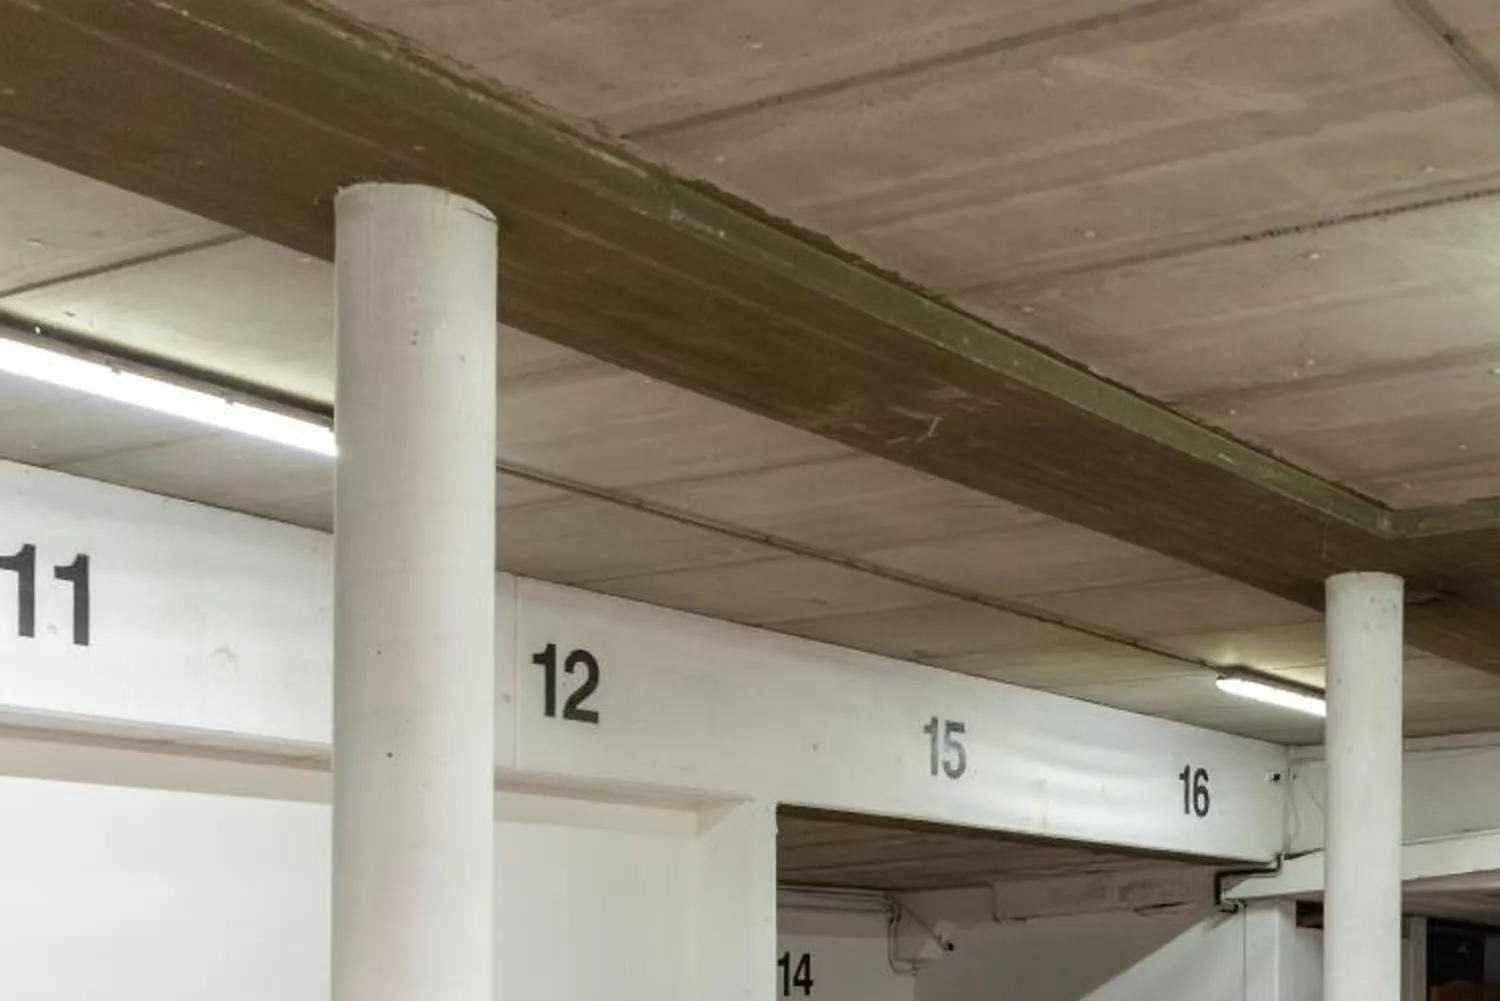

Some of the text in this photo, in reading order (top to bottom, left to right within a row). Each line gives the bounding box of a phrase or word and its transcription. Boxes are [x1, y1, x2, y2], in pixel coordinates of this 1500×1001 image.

[0, 544, 90, 646] 11
[532, 643, 600, 725] 12
[922, 714, 967, 780] 15
[1178, 764, 1212, 818] 16
[777, 951, 814, 997] 14
